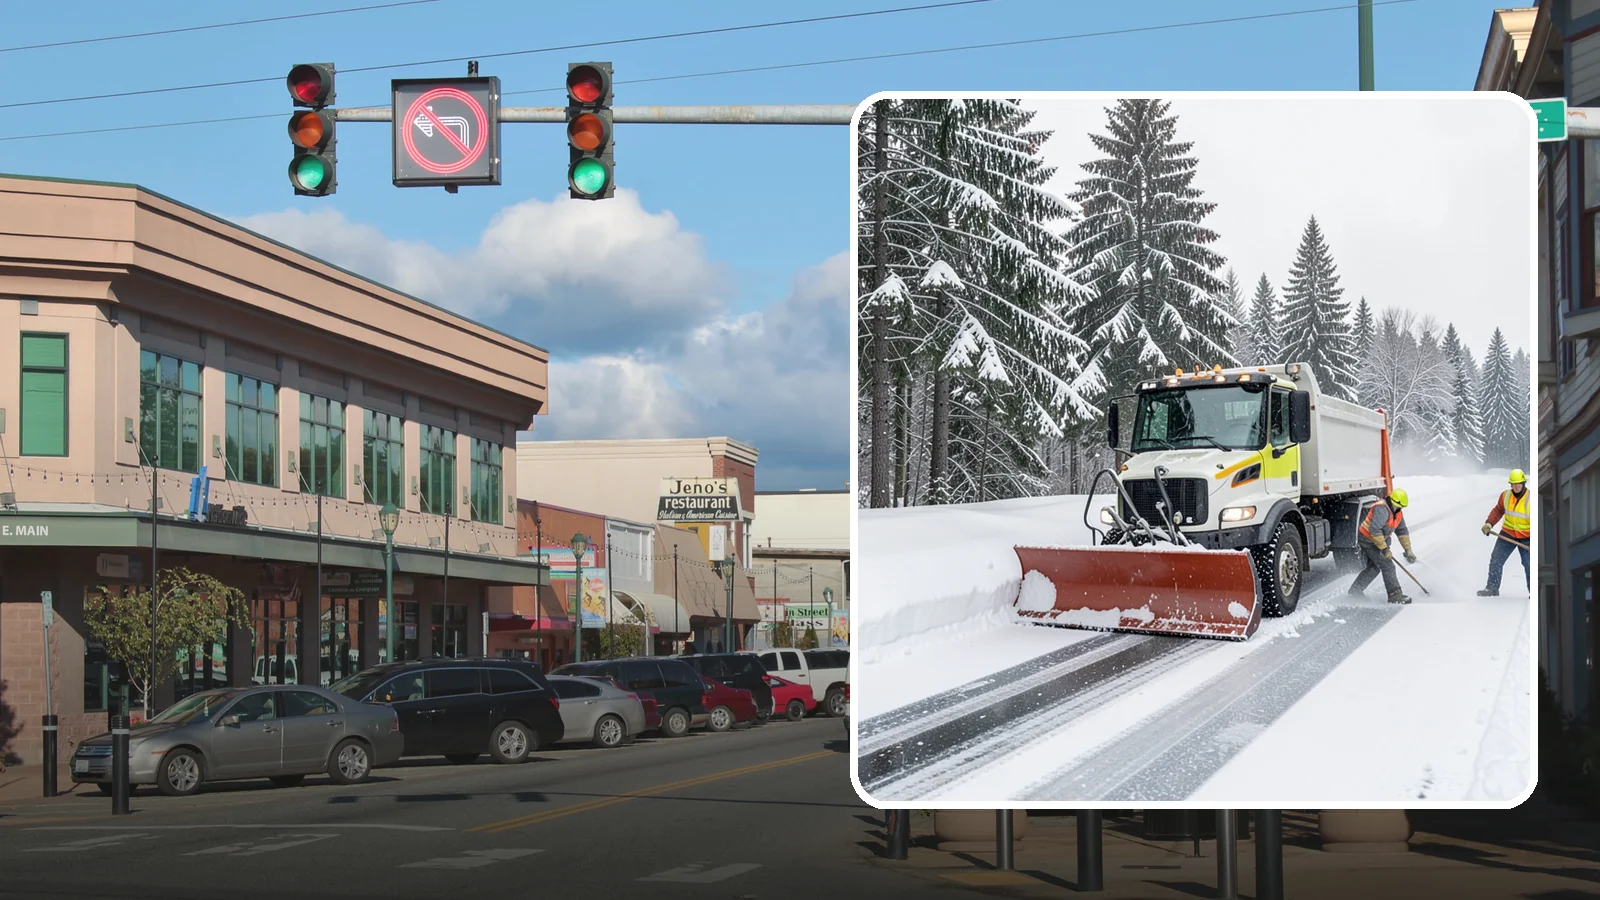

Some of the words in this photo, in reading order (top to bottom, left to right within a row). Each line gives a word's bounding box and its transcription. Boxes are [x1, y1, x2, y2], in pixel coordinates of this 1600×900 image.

[670, 480, 727, 494] Jeno's
[665, 496, 731, 509] restaurant
[658, 509, 682, 519] Italian
[686, 509, 714, 519] American
[715, 509, 738, 519] Cuisine
[2, 525, 13, 536] E.
[15, 525, 49, 536] MAIN
[797, 607, 828, 617] Street
[791, 619, 823, 627] lass
